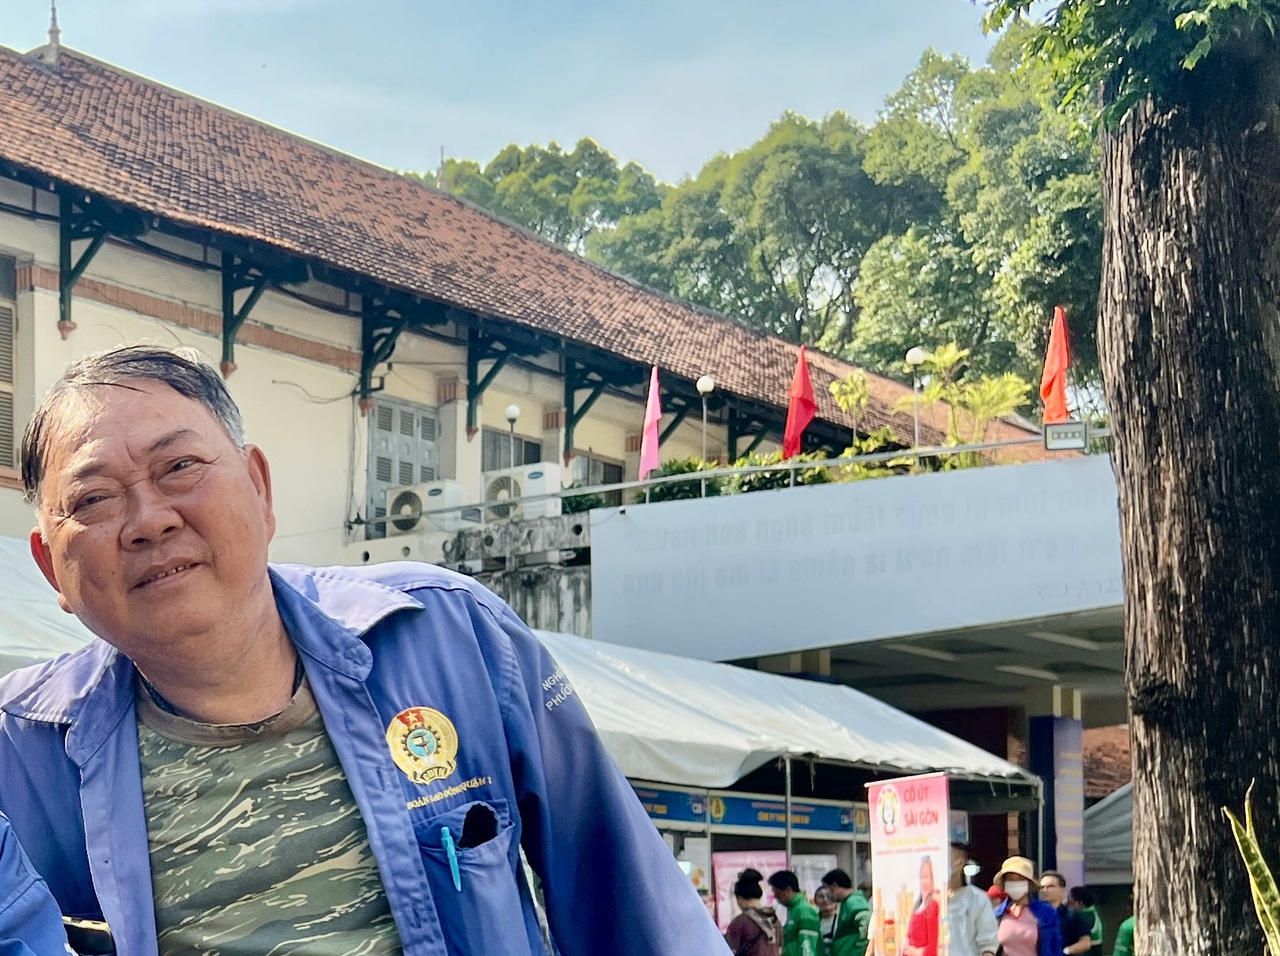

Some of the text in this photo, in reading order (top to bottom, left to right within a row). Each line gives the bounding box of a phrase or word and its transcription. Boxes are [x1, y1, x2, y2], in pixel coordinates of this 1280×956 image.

[903, 785, 916, 803] CÔ
[917, 784, 930, 802] ÚT
[904, 807, 939, 828] SÀI GÒN
